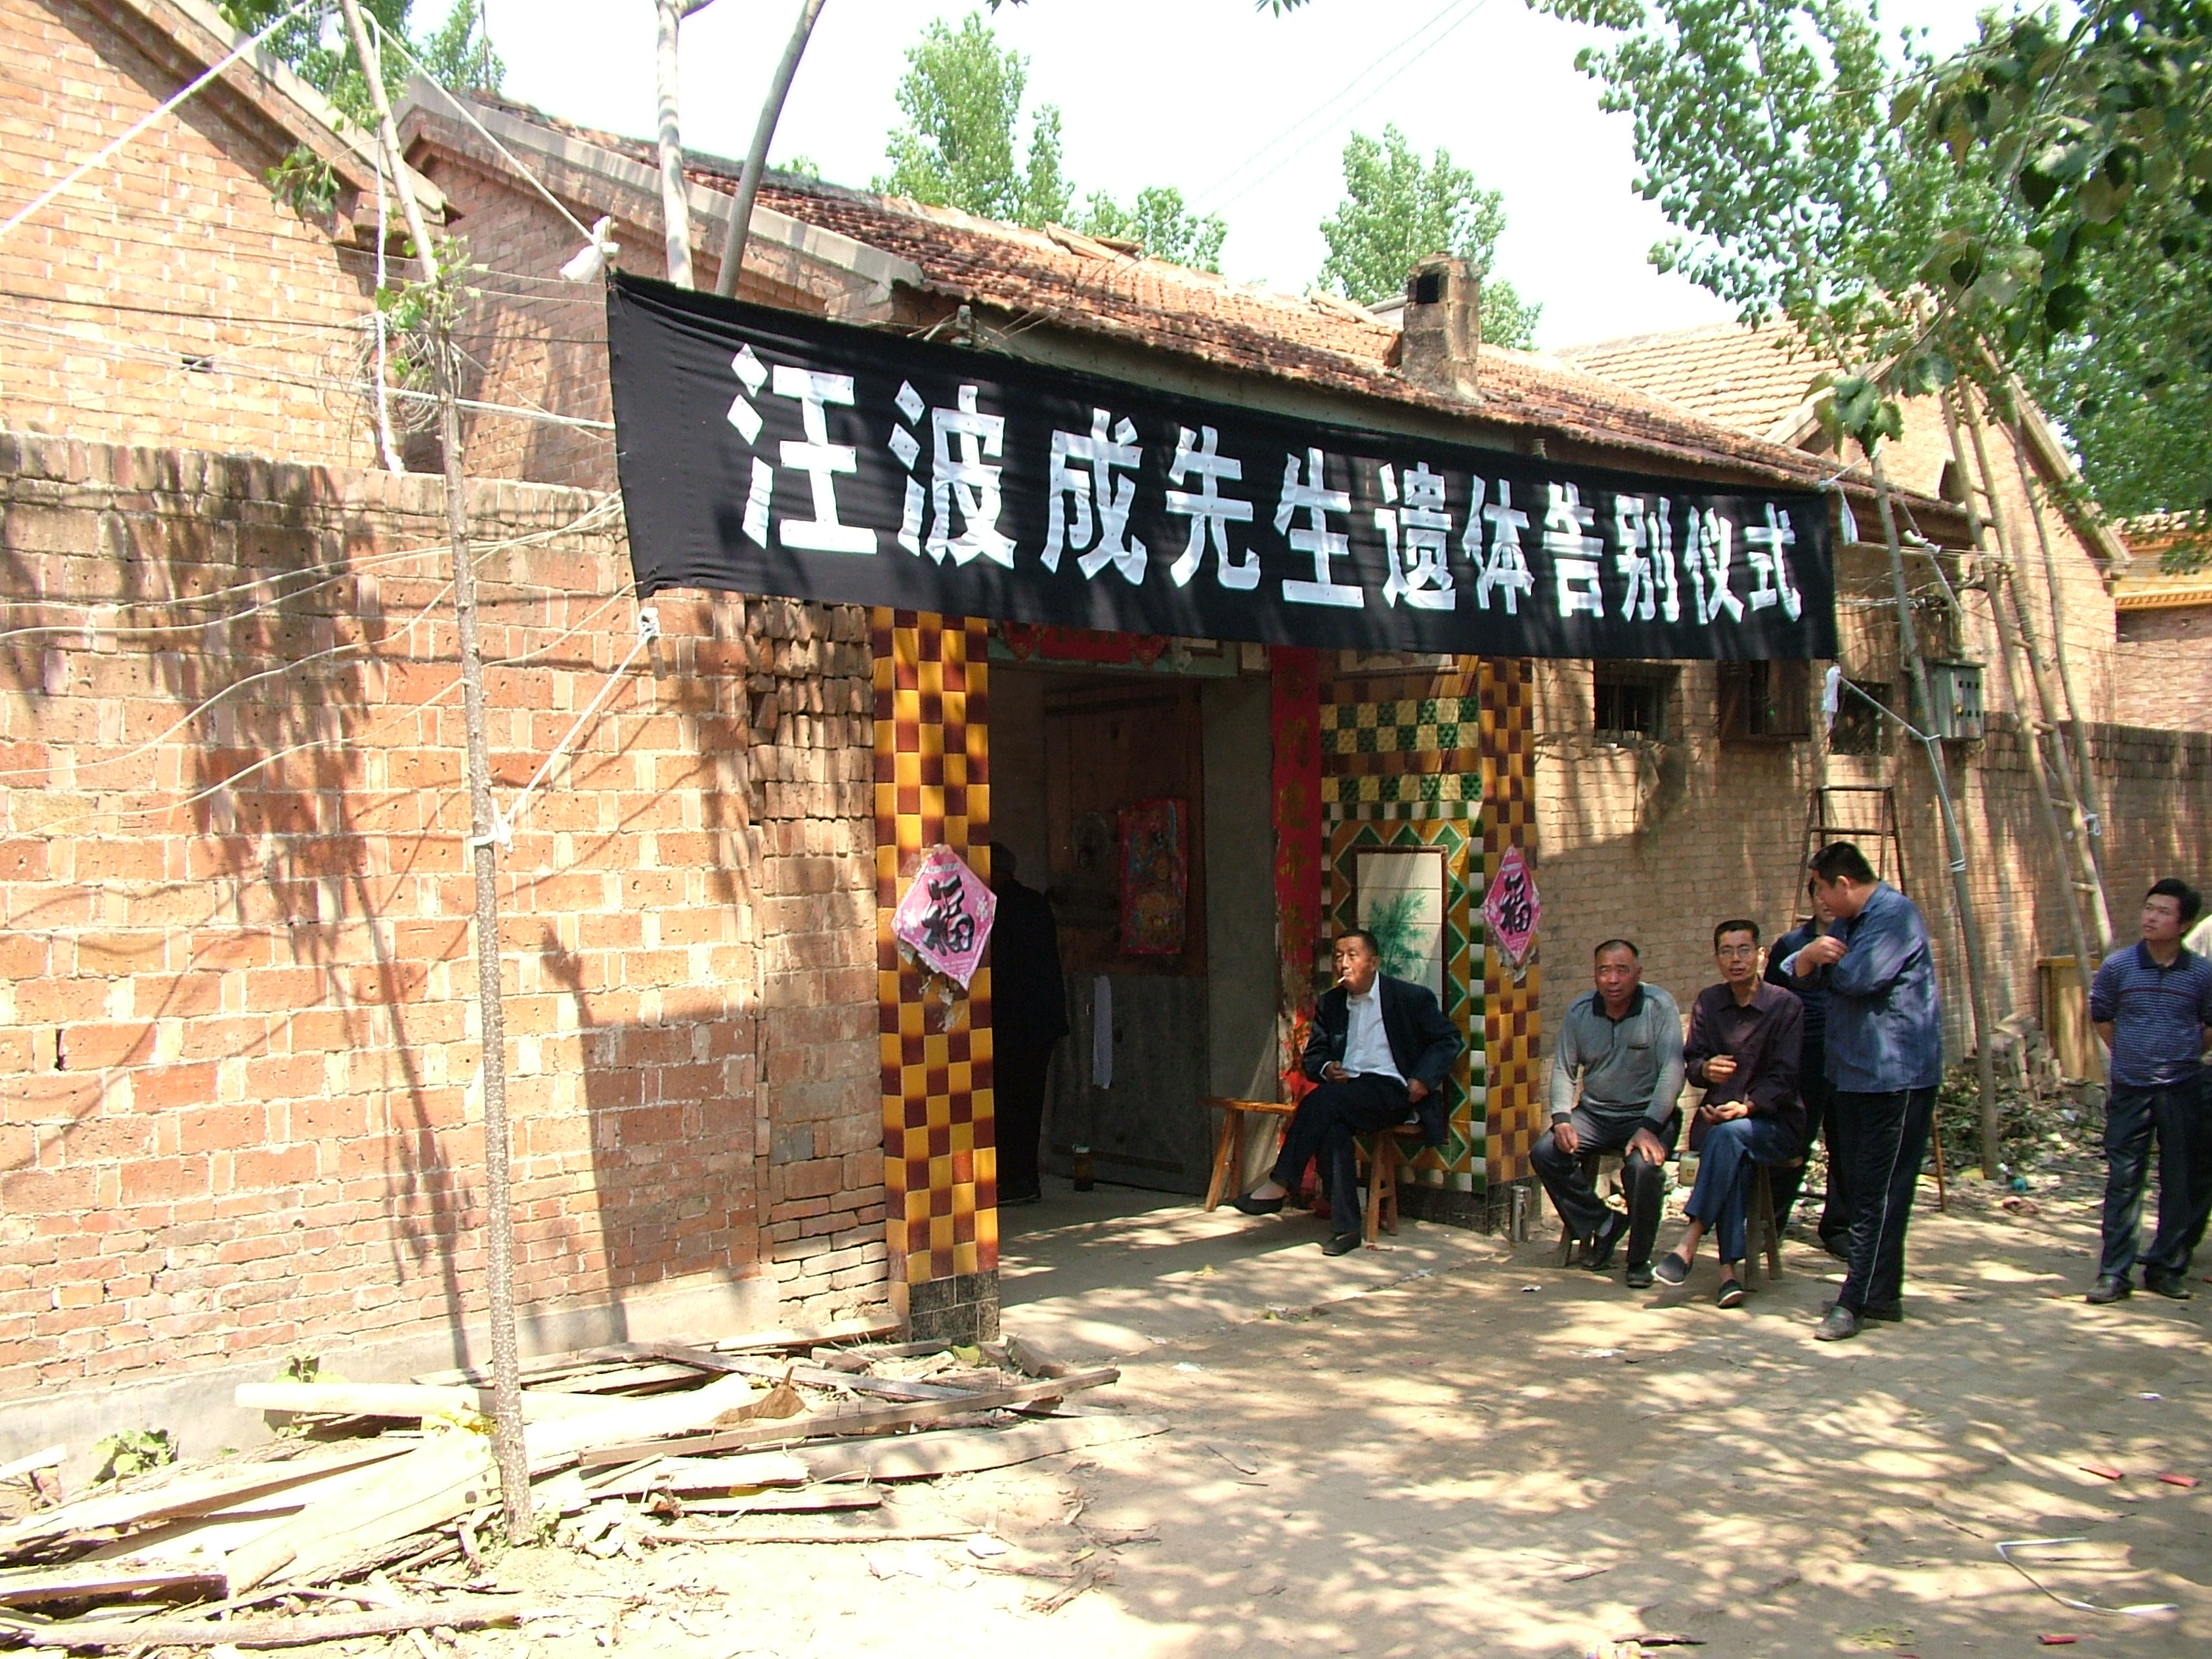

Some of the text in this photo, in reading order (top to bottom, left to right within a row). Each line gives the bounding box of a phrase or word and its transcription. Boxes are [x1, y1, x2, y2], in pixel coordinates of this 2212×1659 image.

[727, 343, 1803, 624] 汪波成先生遗体告别仪式
[921, 875, 976, 956] 福
[1500, 871, 1532, 936] 福
